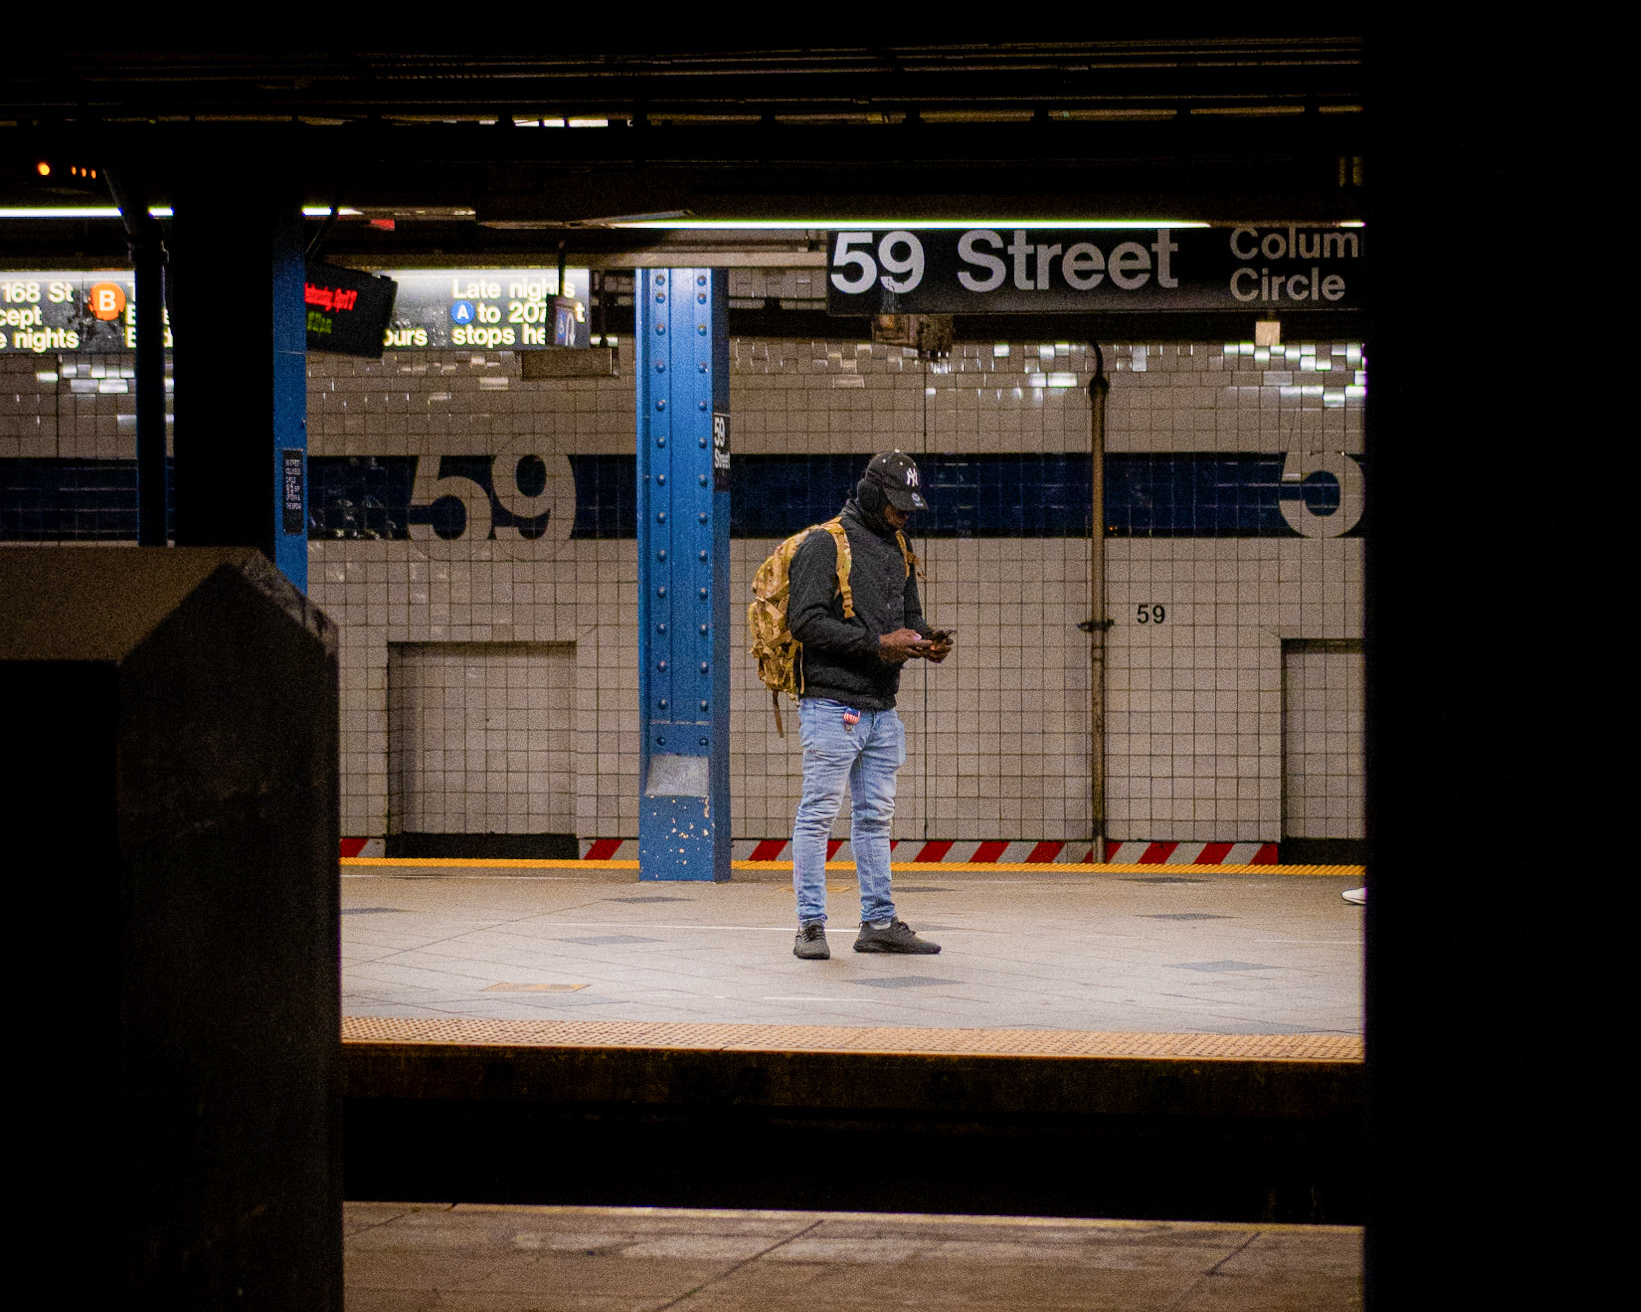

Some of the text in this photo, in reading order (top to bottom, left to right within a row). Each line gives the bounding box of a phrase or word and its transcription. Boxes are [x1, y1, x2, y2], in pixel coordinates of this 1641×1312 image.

[830, 228, 1179, 294] 59 Street
[1, 281, 75, 303] 168 St
[452, 279, 502, 299] Late
[1229, 267, 1346, 301] Circle
[99, 290, 117, 311] B
[456, 304, 470, 320] A
[477, 302, 502, 323] to
[508, 301, 548, 323] 207
[13, 326, 80, 353] nights
[452, 323, 516, 349] stops
[714, 416, 725, 447] 59
[1278, 425, 1366, 539] 5
[407, 434, 578, 560] 59
[1136, 604, 1166, 624] 59
